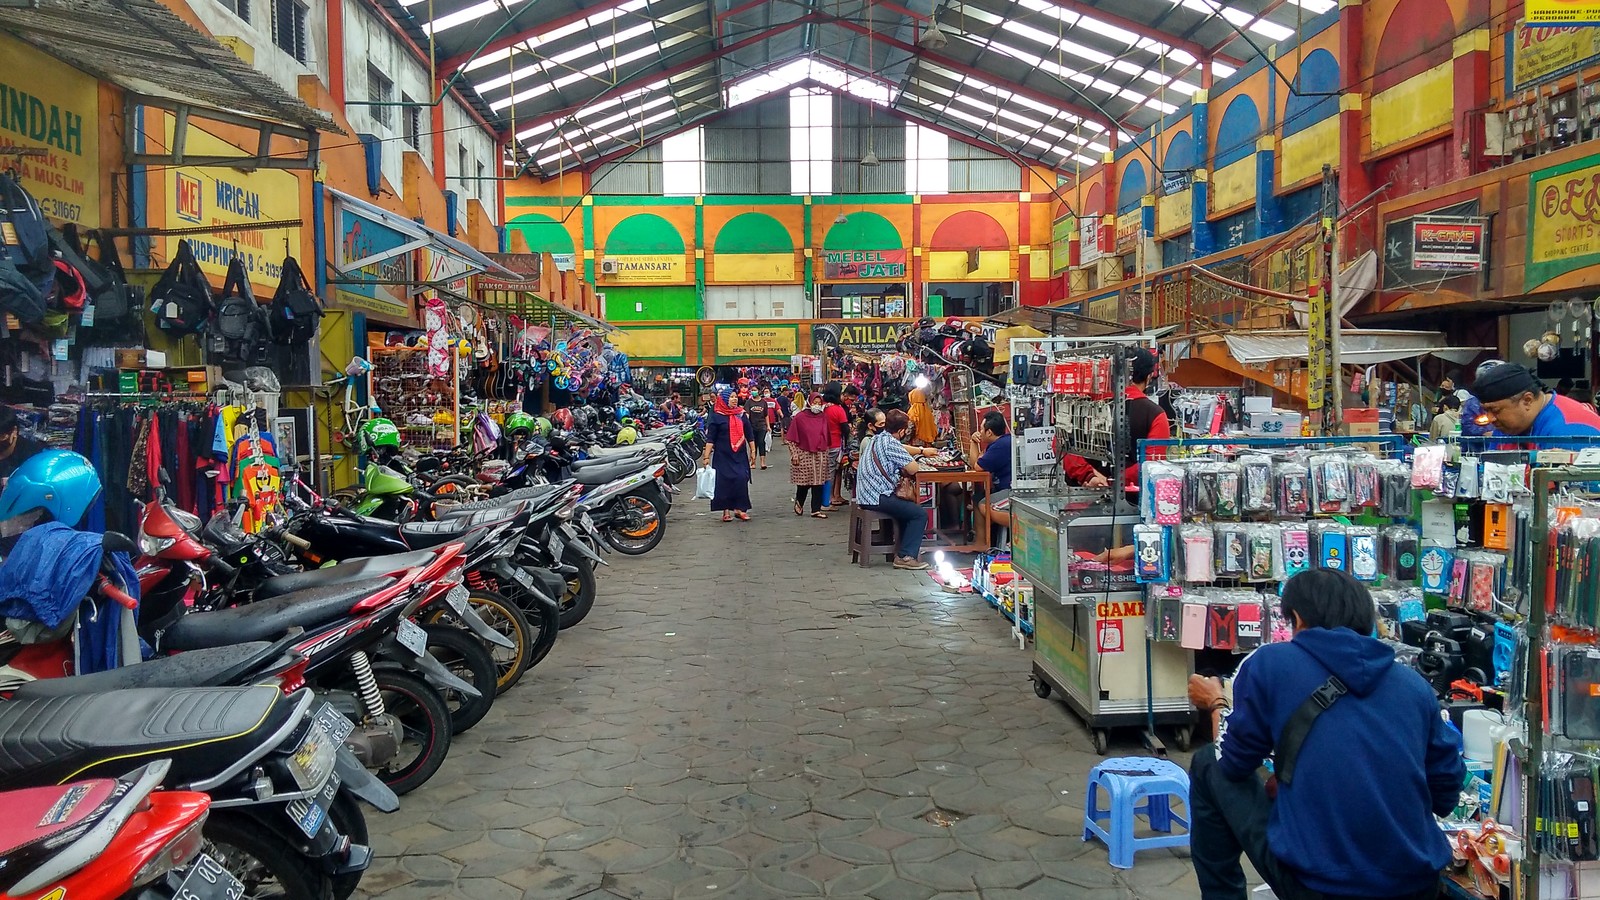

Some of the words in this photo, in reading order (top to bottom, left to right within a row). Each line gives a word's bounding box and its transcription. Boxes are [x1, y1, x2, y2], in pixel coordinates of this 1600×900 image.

[0, 83, 82, 156] INDAH
[35, 166, 84, 195] MUSLIM
[180, 178, 198, 216] ME
[215, 178, 259, 220] MRICAN
[52, 199, 81, 221] 311667
[1421, 230, 1475, 243] K-GAME
[827, 252, 887, 263] MEBEL
[860, 263, 905, 277] JATI
[839, 326, 899, 343] ATILLA
